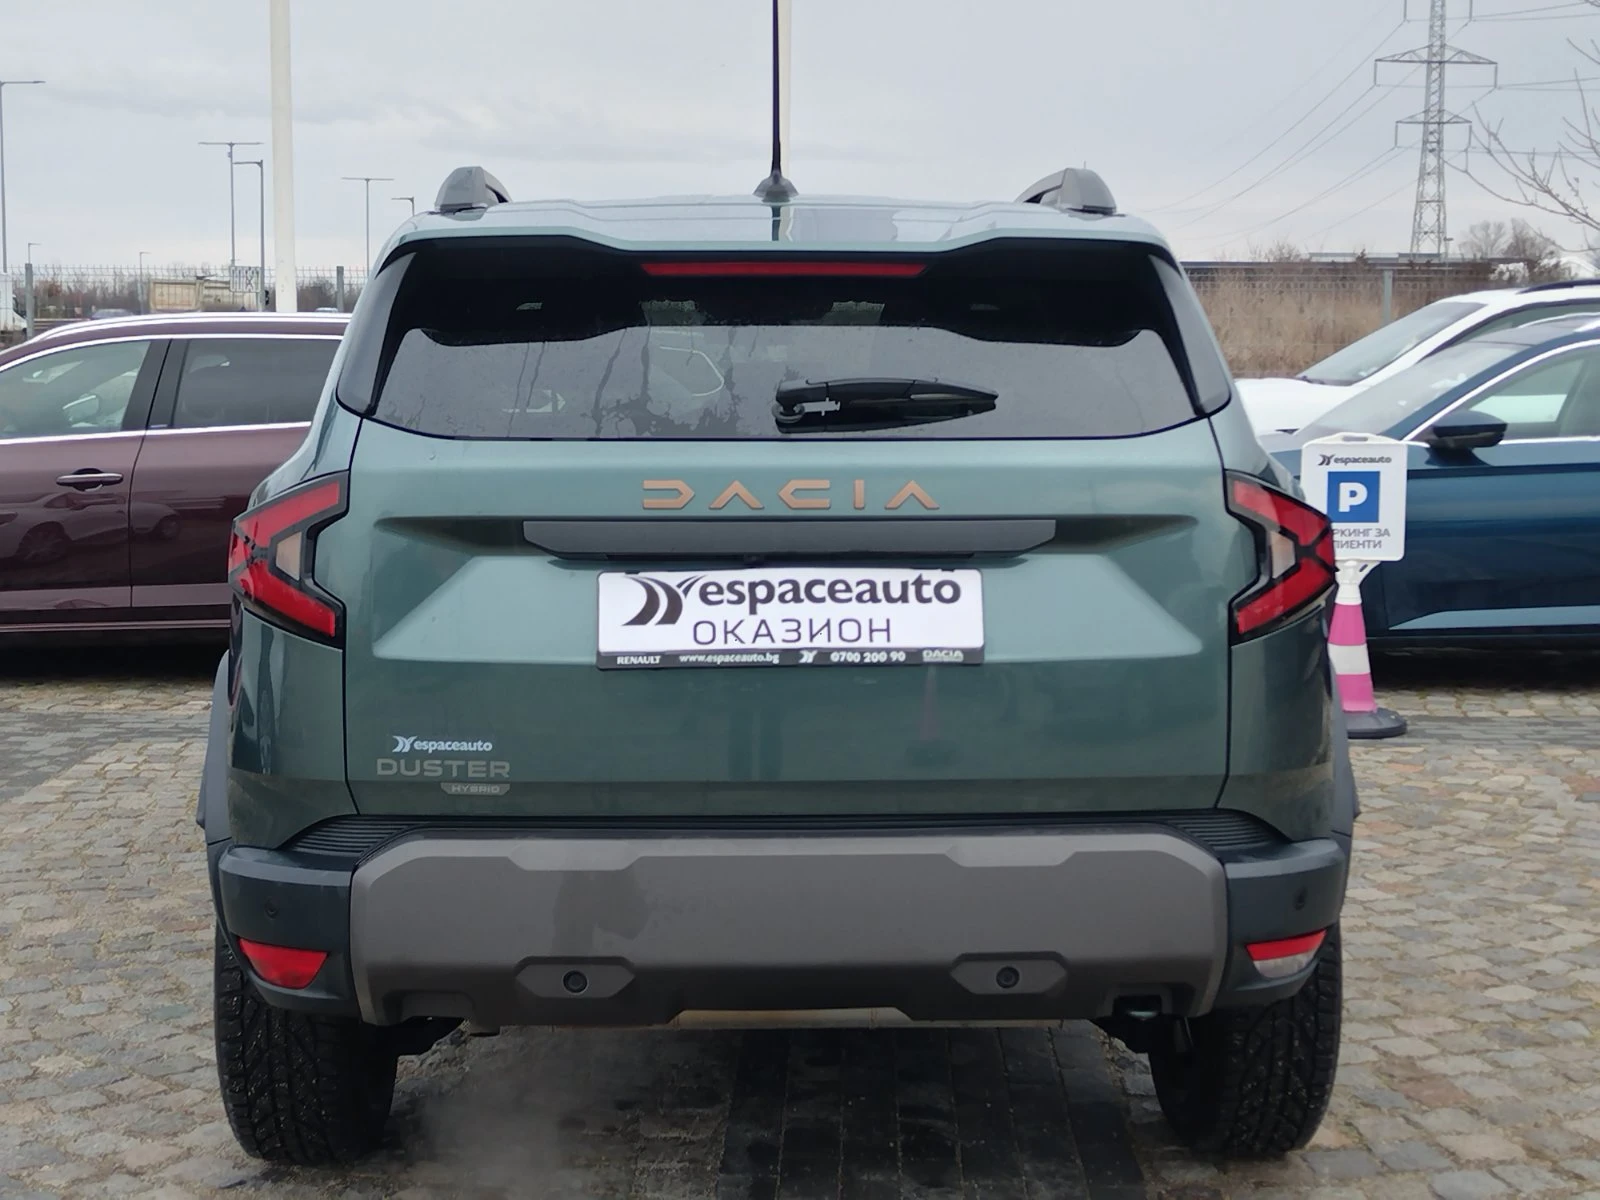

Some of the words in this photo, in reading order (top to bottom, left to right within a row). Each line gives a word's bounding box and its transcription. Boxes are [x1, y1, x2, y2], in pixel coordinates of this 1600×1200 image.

[1333, 455, 1392, 466] espaceauto
[642, 479, 940, 510] DACIA
[1338, 482, 1368, 512] P
[1333, 528, 1372, 537] РКИНГ
[1375, 528, 1391, 537] ЗА
[1334, 540, 1382, 549] ЛИЕНТИ
[698, 573, 961, 615] espaceauto
[692, 617, 892, 646] ОКАЗИОН
[616, 655, 661, 665] RENAULT
[679, 652, 780, 665] www.espaceauto.bg
[830, 651, 860, 663] 0700
[863, 651, 887, 663] 200
[889, 651, 907, 662] 90
[922, 649, 964, 662] DACIA
[413, 739, 493, 754] espaceauto
[376, 758, 511, 778] DUSTER
[451, 783, 501, 794] HYBRID
